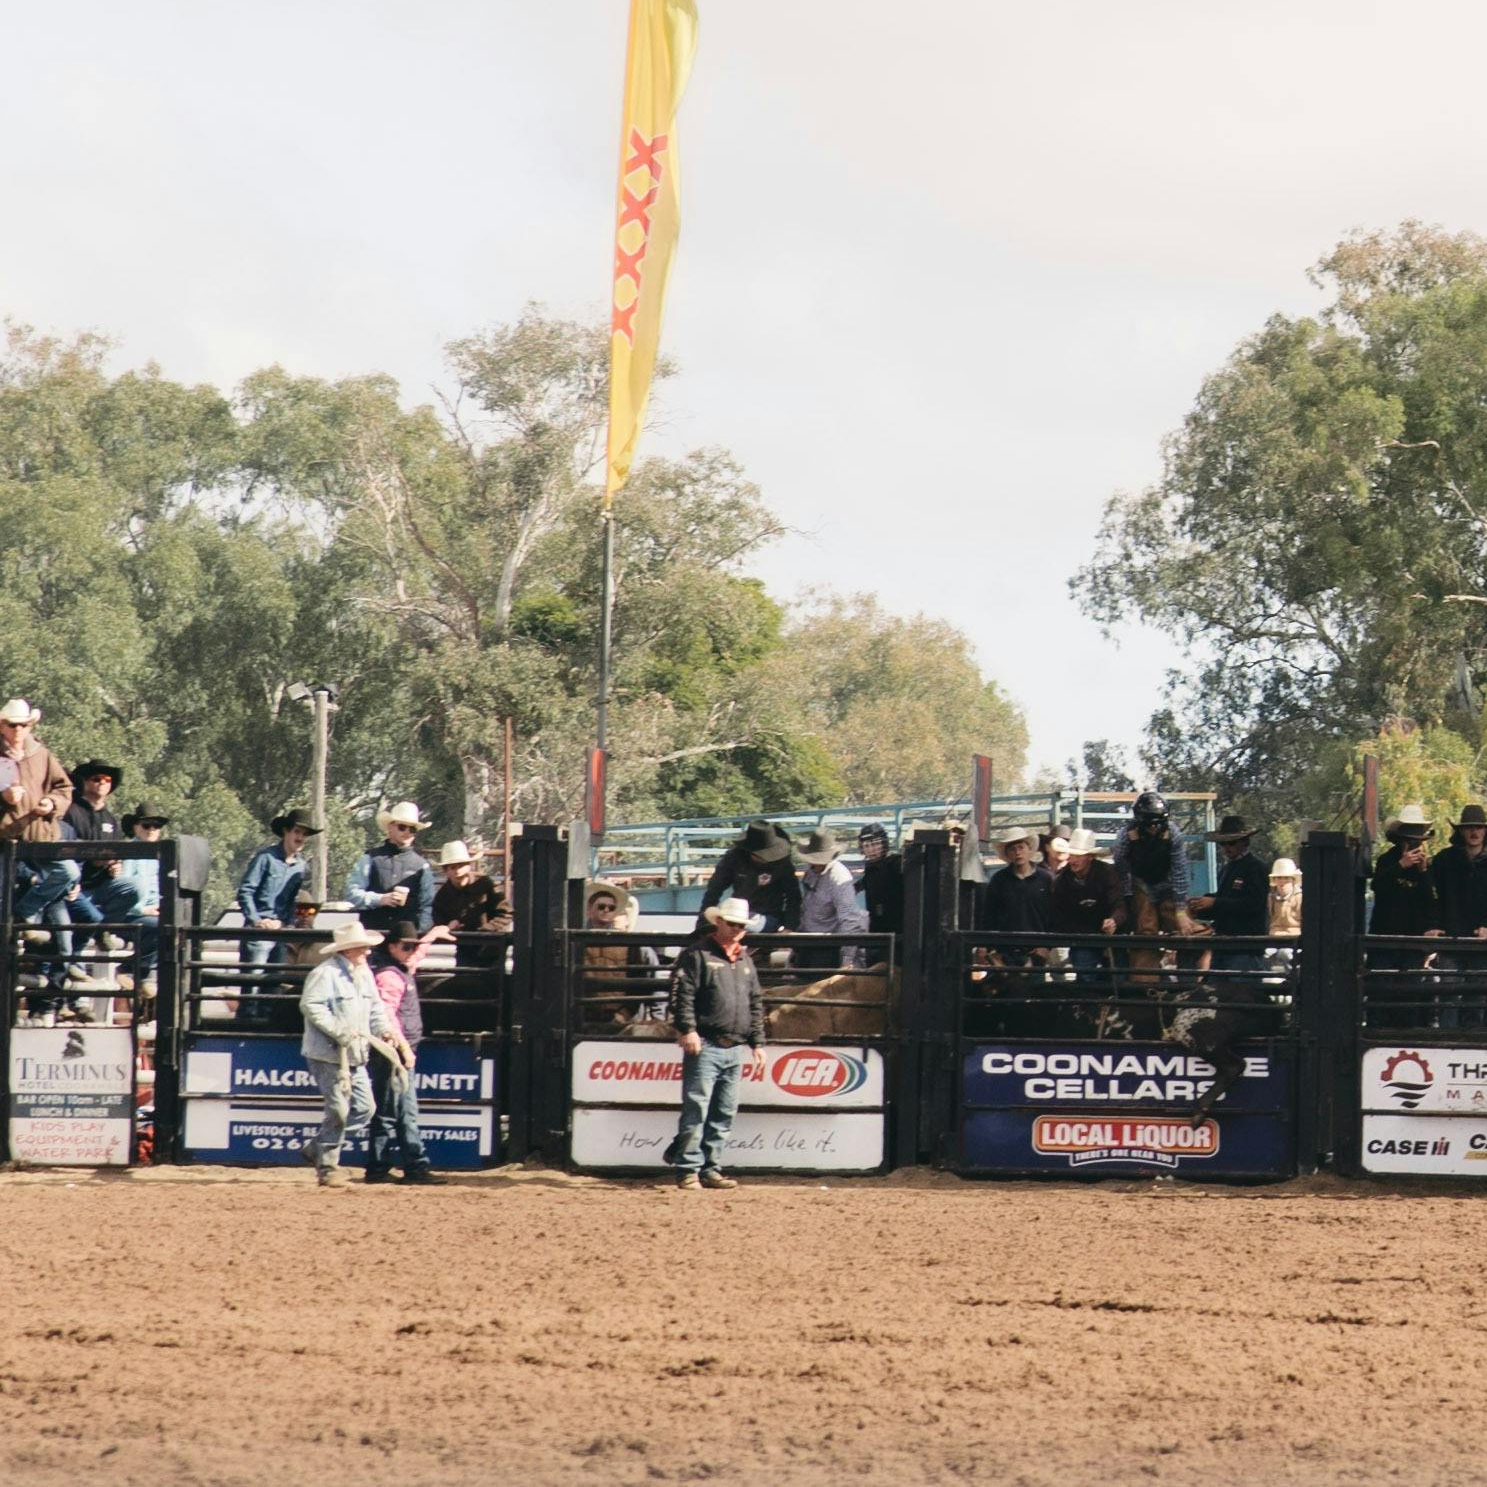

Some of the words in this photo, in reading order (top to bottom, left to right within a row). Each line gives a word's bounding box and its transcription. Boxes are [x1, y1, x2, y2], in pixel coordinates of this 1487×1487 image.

[779, 1058, 830, 1087] IGA
[982, 1052, 1271, 1078] COONAMBE
[38, 1095, 65, 1105] OPEN
[31, 1121, 66, 1132] KIDS
[72, 1121, 106, 1132] PLAY
[233, 1125, 294, 1137] LIVESTOCK
[1041, 1123, 1120, 1146] LOCAL
[444, 1129, 479, 1142] SALES
[620, 1131, 663, 1149] How
[773, 1128, 807, 1151] like
[1367, 1139, 1429, 1155] CASE
